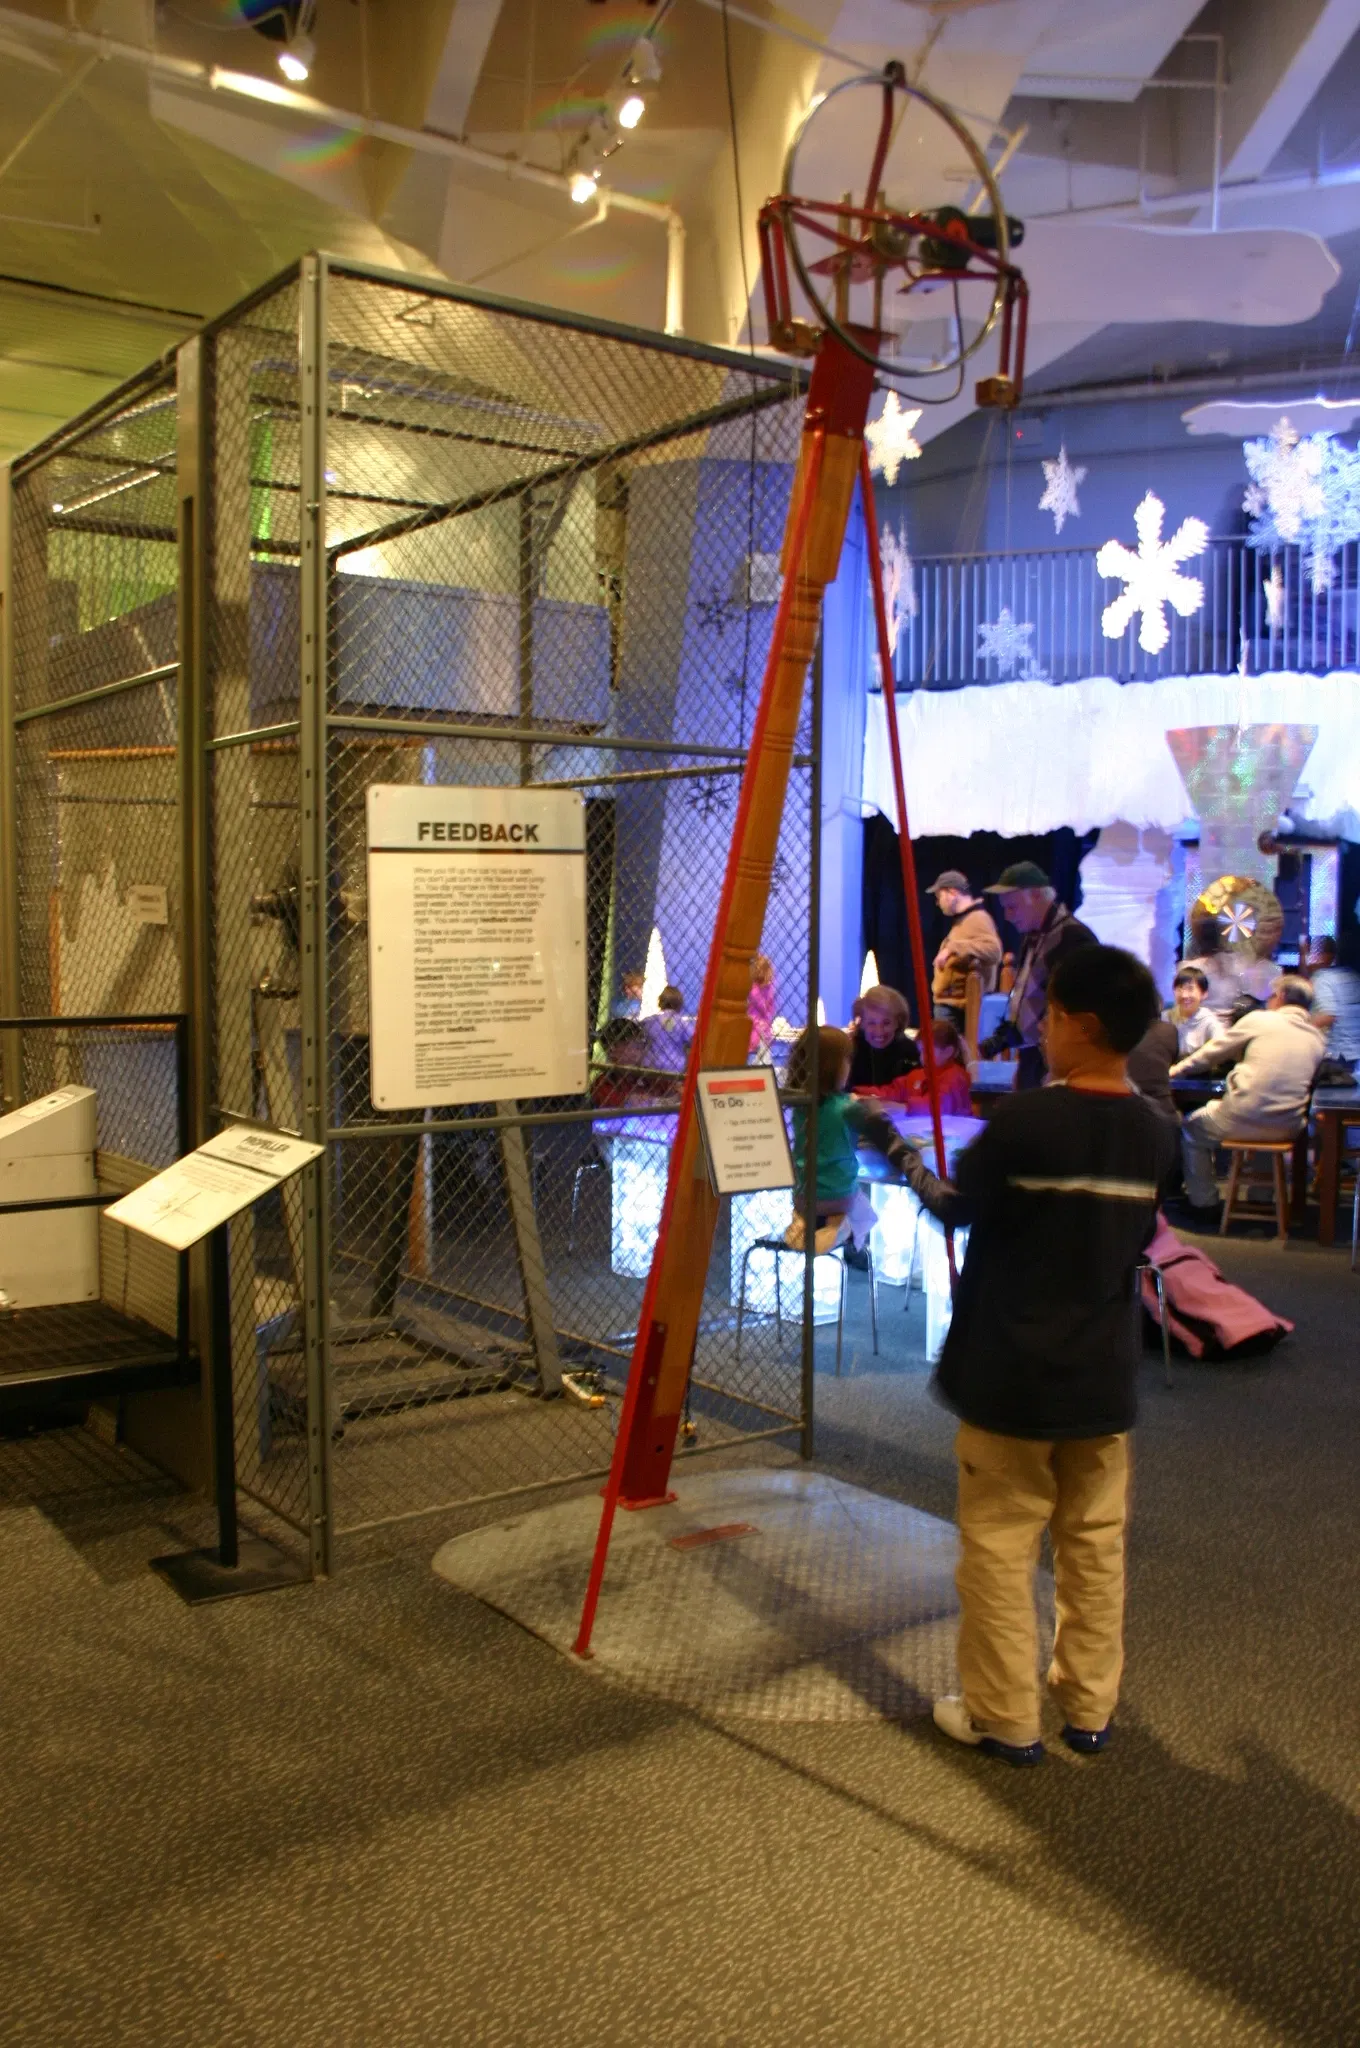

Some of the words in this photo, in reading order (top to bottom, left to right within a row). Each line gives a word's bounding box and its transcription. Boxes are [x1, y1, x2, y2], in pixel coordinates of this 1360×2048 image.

[417, 822, 540, 843] FEEDBACK
[711, 1098, 725, 1109] To
[728, 1097, 744, 1108] Do
[242, 1136, 291, 1153] PROPELLER
